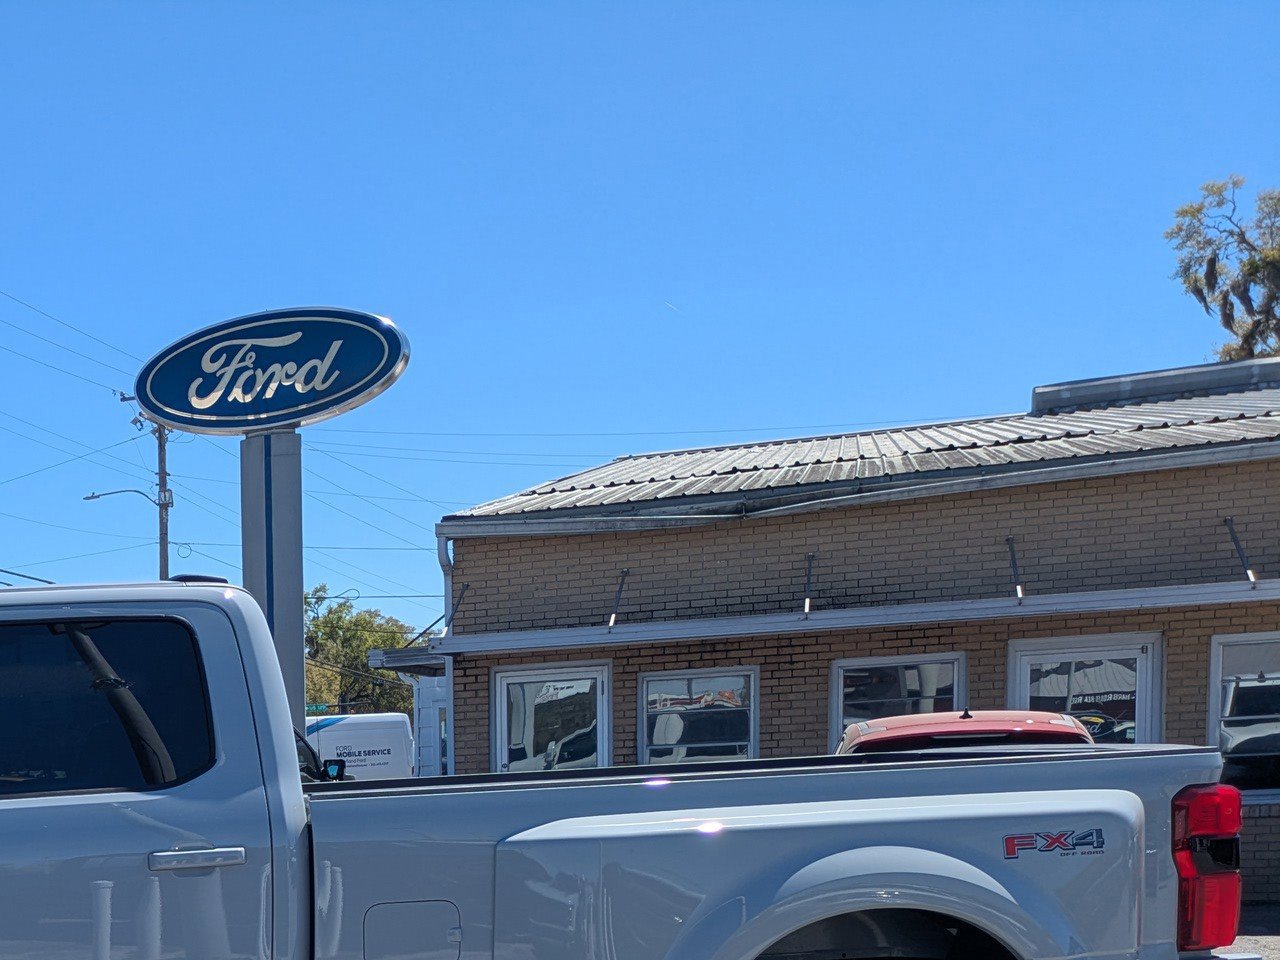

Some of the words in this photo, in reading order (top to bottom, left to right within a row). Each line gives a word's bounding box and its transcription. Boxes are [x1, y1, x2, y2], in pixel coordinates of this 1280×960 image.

[187, 331, 344, 410] Ford
[363, 748, 391, 756] SERVICE
[1002, 828, 1106, 859] FX4
